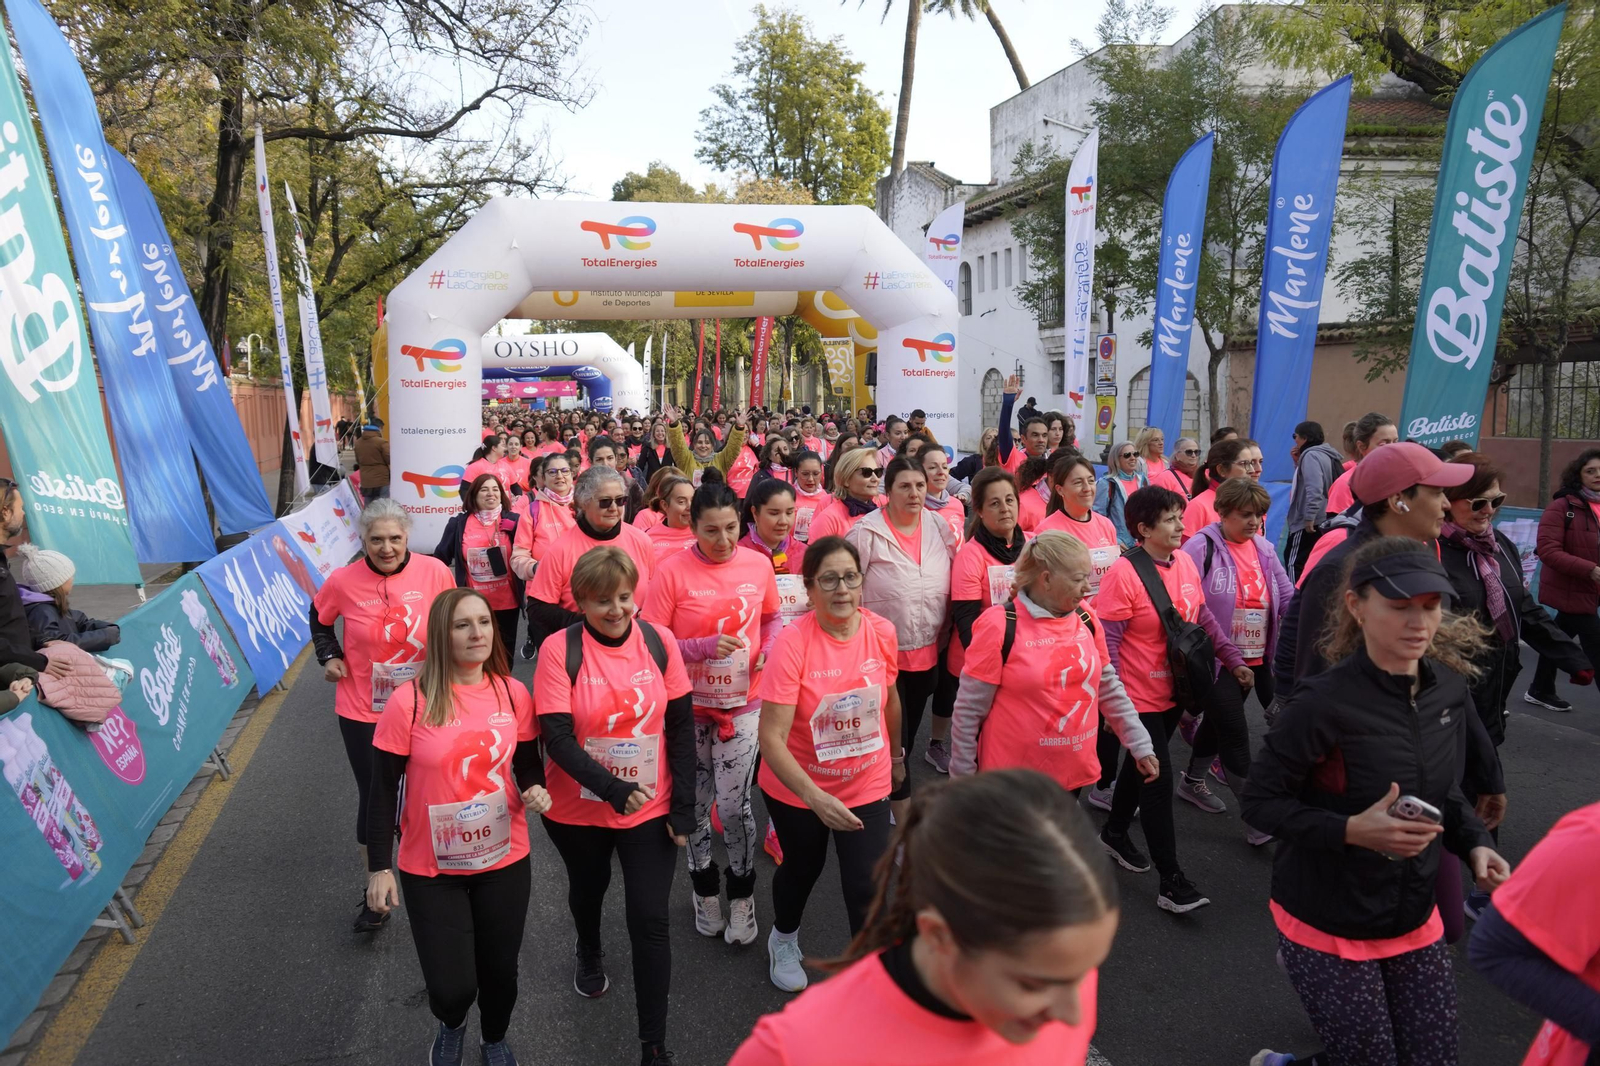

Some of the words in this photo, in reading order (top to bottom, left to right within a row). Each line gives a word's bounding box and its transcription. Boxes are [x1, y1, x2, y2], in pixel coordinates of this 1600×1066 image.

[1426, 93, 1528, 370] Batiste
[581, 258, 658, 270] TotalEnergies
[734, 258, 804, 270] TotalEnergies
[1266, 194, 1319, 339] Marlene
[1157, 232, 1195, 358] Marlene
[614, 299, 650, 308] Deportes
[494, 340, 578, 358] OYSHO
[756, 316, 768, 371] Santander
[902, 368, 956, 378] TotalEnergies
[400, 378, 466, 390] TotalEnergies
[1406, 412, 1476, 438] Batiste
[400, 427, 466, 436] totalenergies.es
[1454, 432, 1474, 441] SECO
[402, 504, 464, 516] TotalEnergie
[224, 546, 310, 670] Marlene
[356, 598, 382, 608] OYSHO
[1246, 630, 1261, 638] 016
[1025, 638, 1056, 648] OYSHO
[140, 623, 182, 726] Batiste
[708, 674, 732, 685] 016
[809, 668, 842, 679] OYSHO
[172, 698, 188, 751] CHAMPÚ
[834, 717, 861, 732] 016
[1039, 736, 1070, 746] CARRERA
[1072, 734, 1080, 744] DE
[1080, 732, 1086, 742] LA
[116, 744, 140, 772] ESPAÑA
[818, 748, 842, 758] OYSHO
[610, 766, 638, 778] 016
[808, 764, 840, 776] CARRERA
[842, 768, 852, 776] DE
[462, 826, 492, 842] 016
